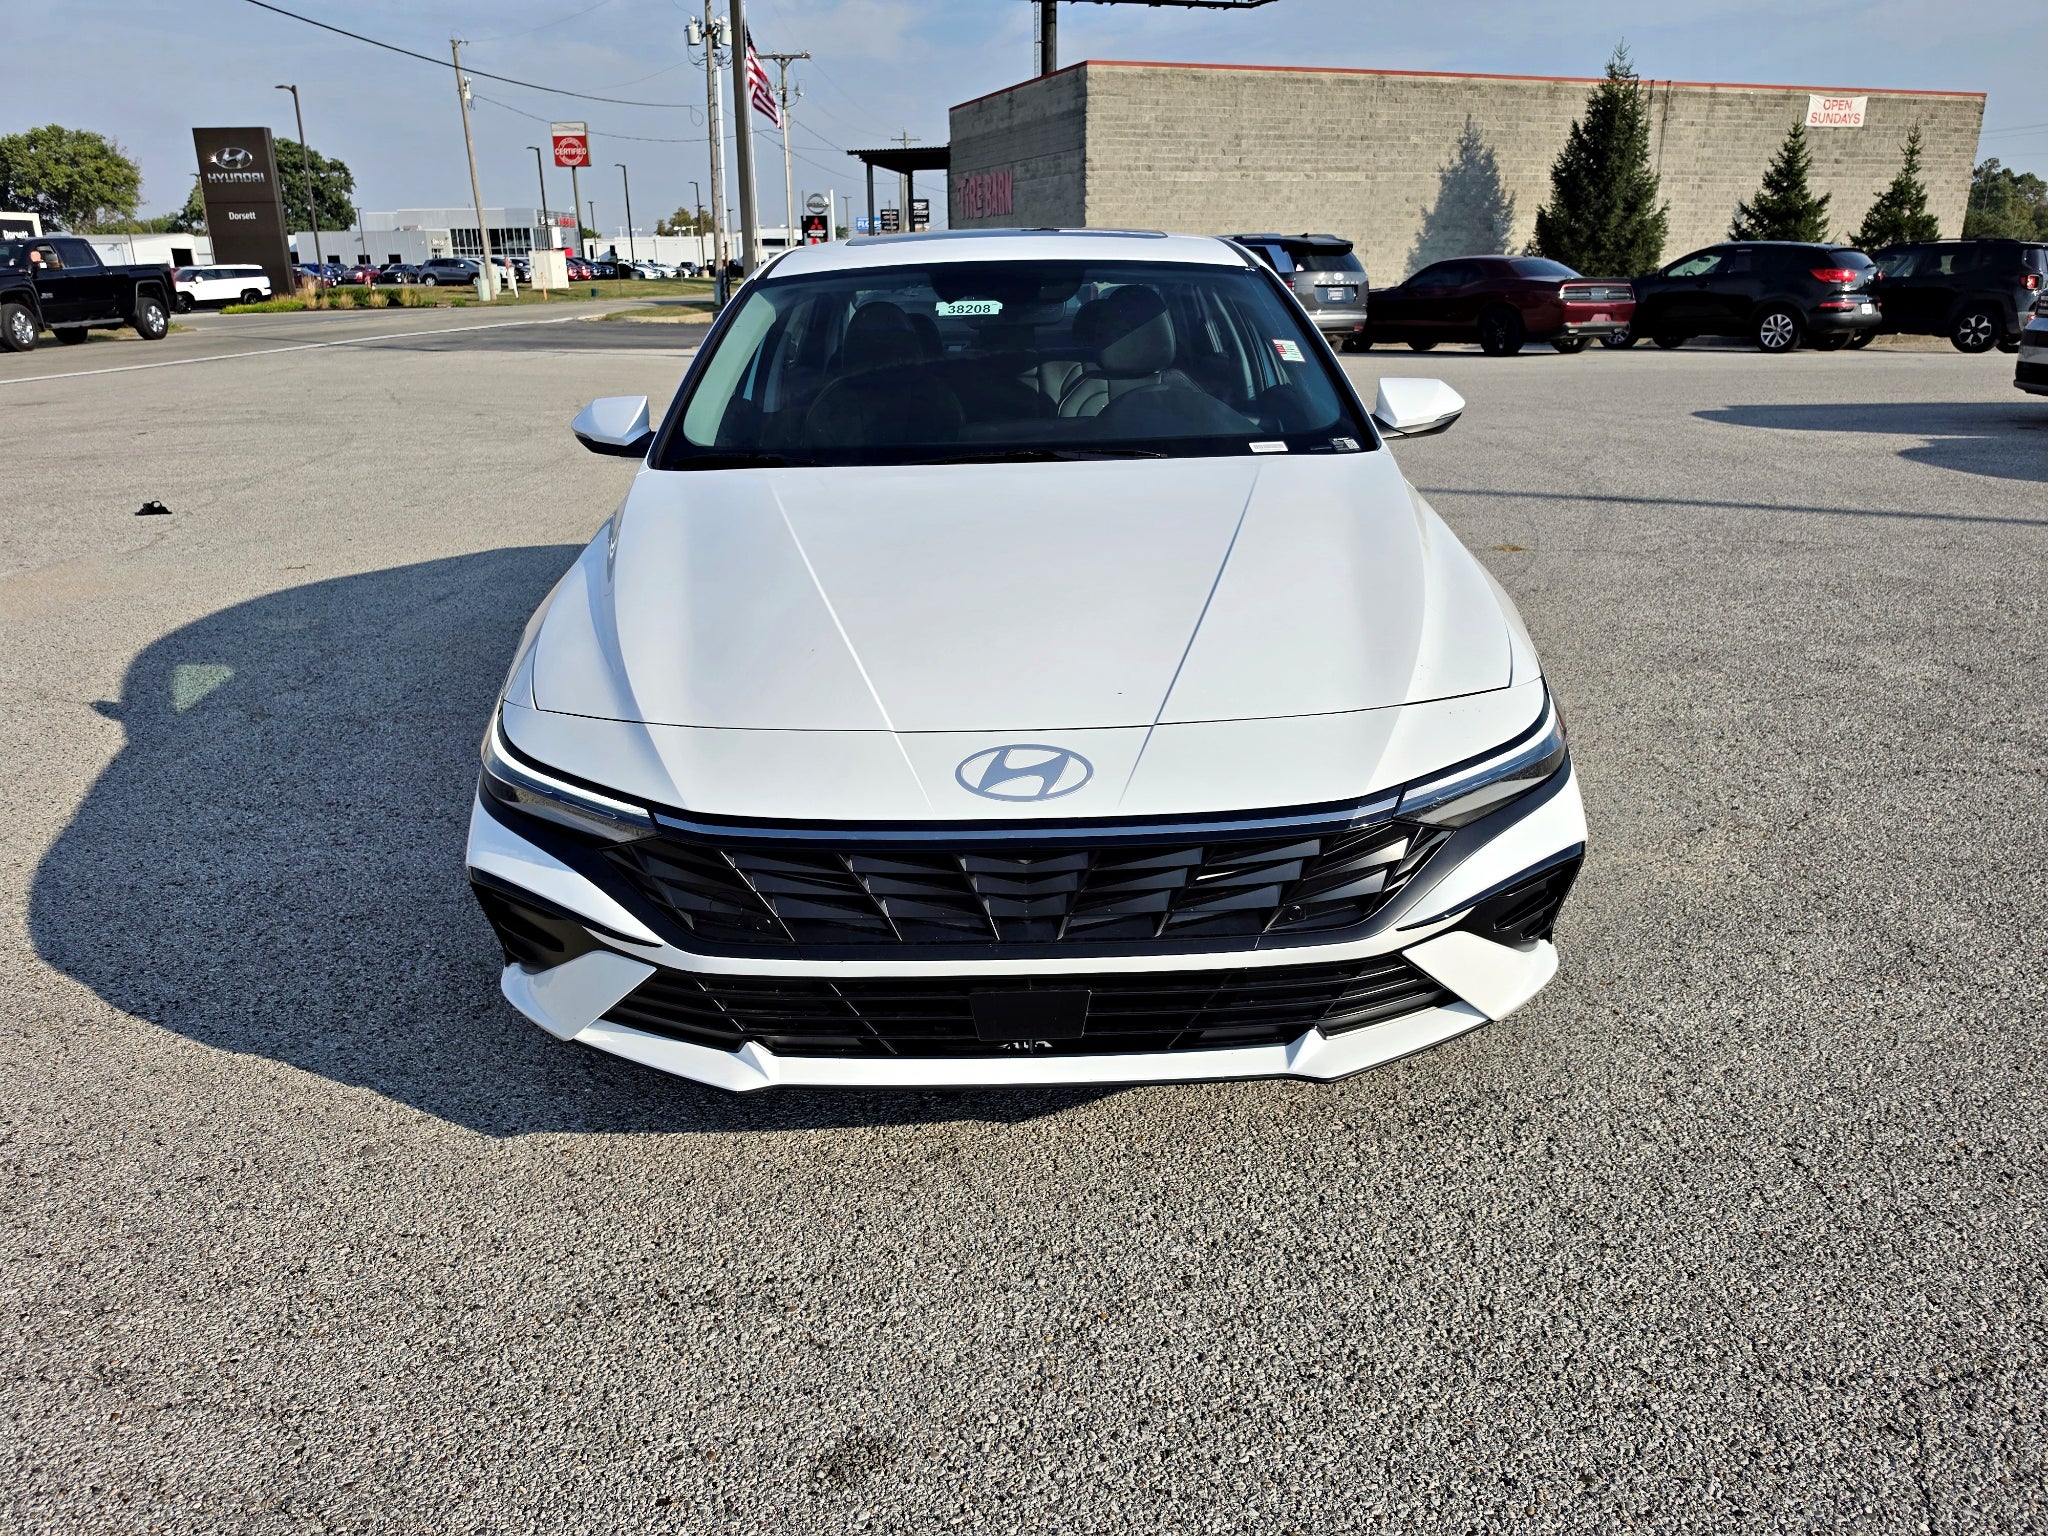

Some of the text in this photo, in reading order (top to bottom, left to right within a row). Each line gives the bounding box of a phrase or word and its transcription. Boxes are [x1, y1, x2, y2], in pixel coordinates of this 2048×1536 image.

[1823, 99, 1853, 111] OPEN
[1810, 112, 1861, 125] SUNDAYS
[554, 147, 587, 156] CERTIFIED
[207, 172, 265, 183] HYUNDAI
[985, 169, 1013, 217] BARN
[228, 211, 257, 221] Dorsett
[947, 304, 991, 314] 38208
